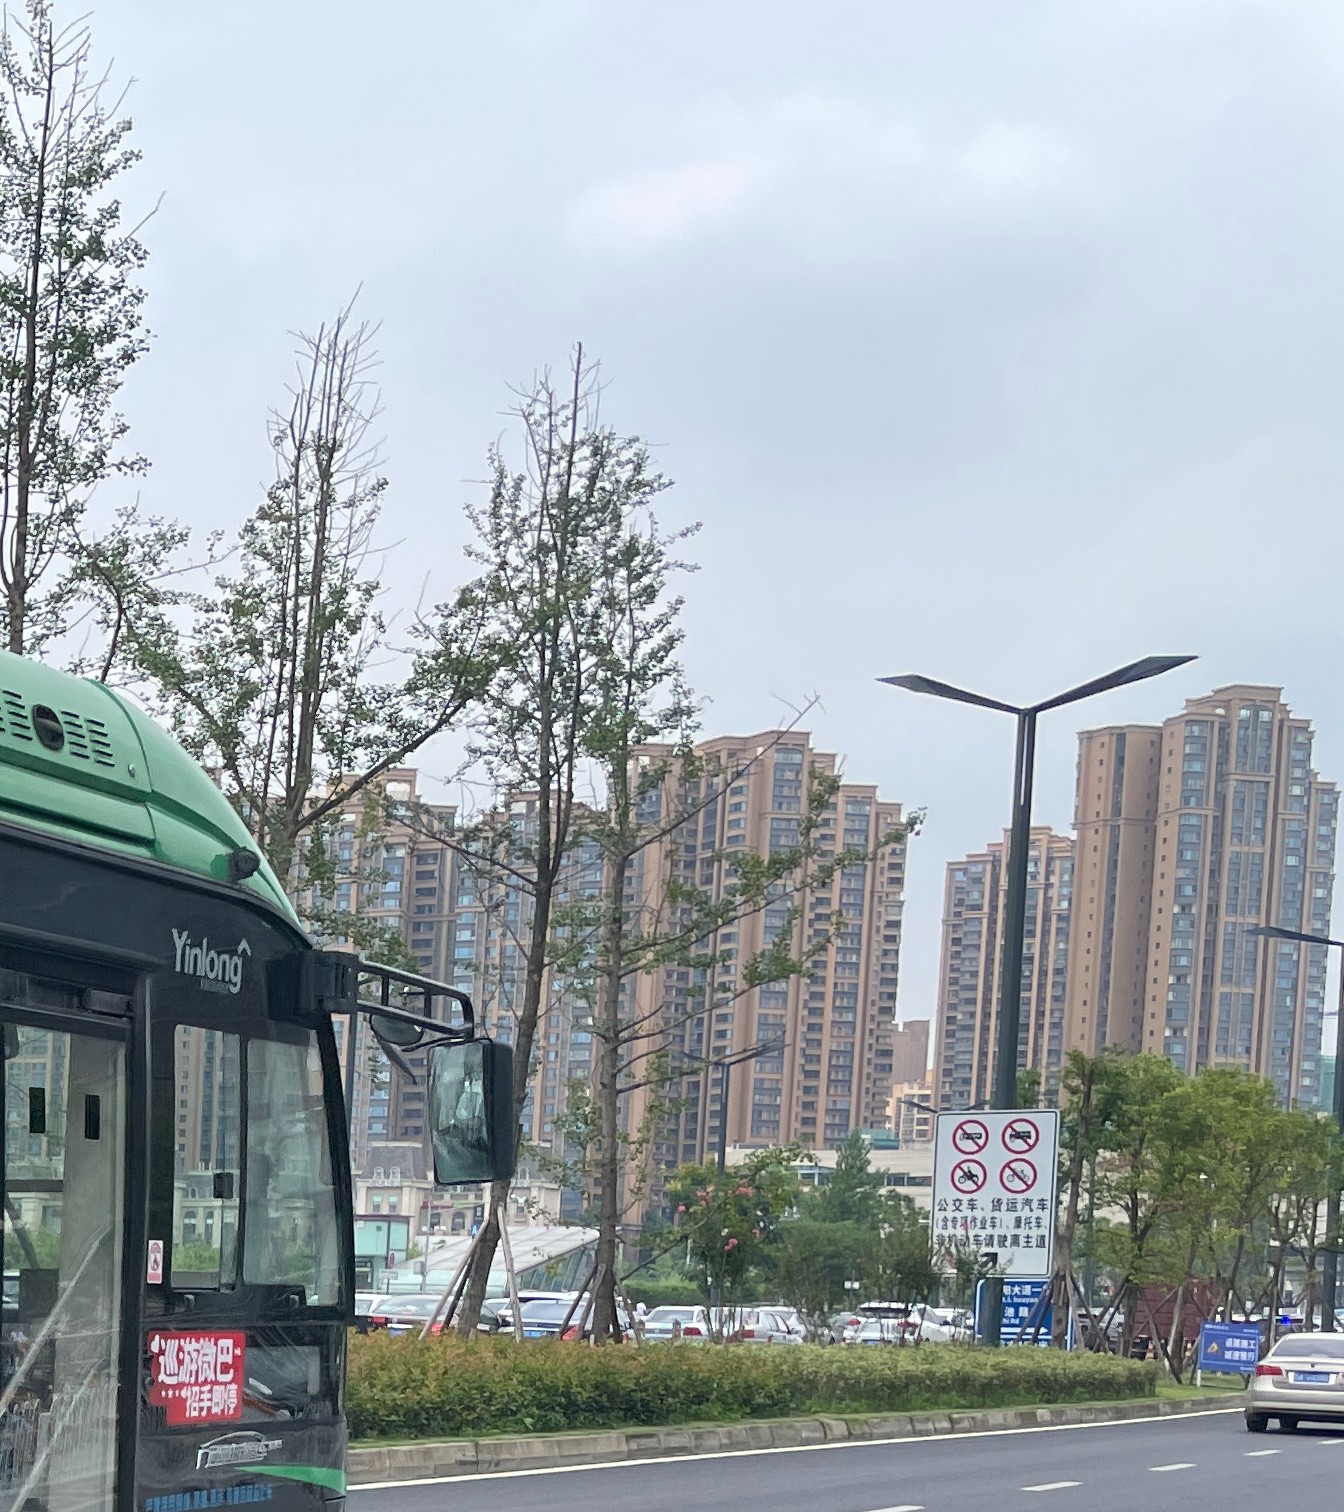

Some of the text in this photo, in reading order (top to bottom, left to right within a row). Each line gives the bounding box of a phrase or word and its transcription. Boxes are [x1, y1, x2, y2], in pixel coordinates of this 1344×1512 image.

[172, 928, 243, 994] Yinlong
[158, 1337, 234, 1384] 巡游微巴
[185, 1384, 238, 1418] 招手即停
